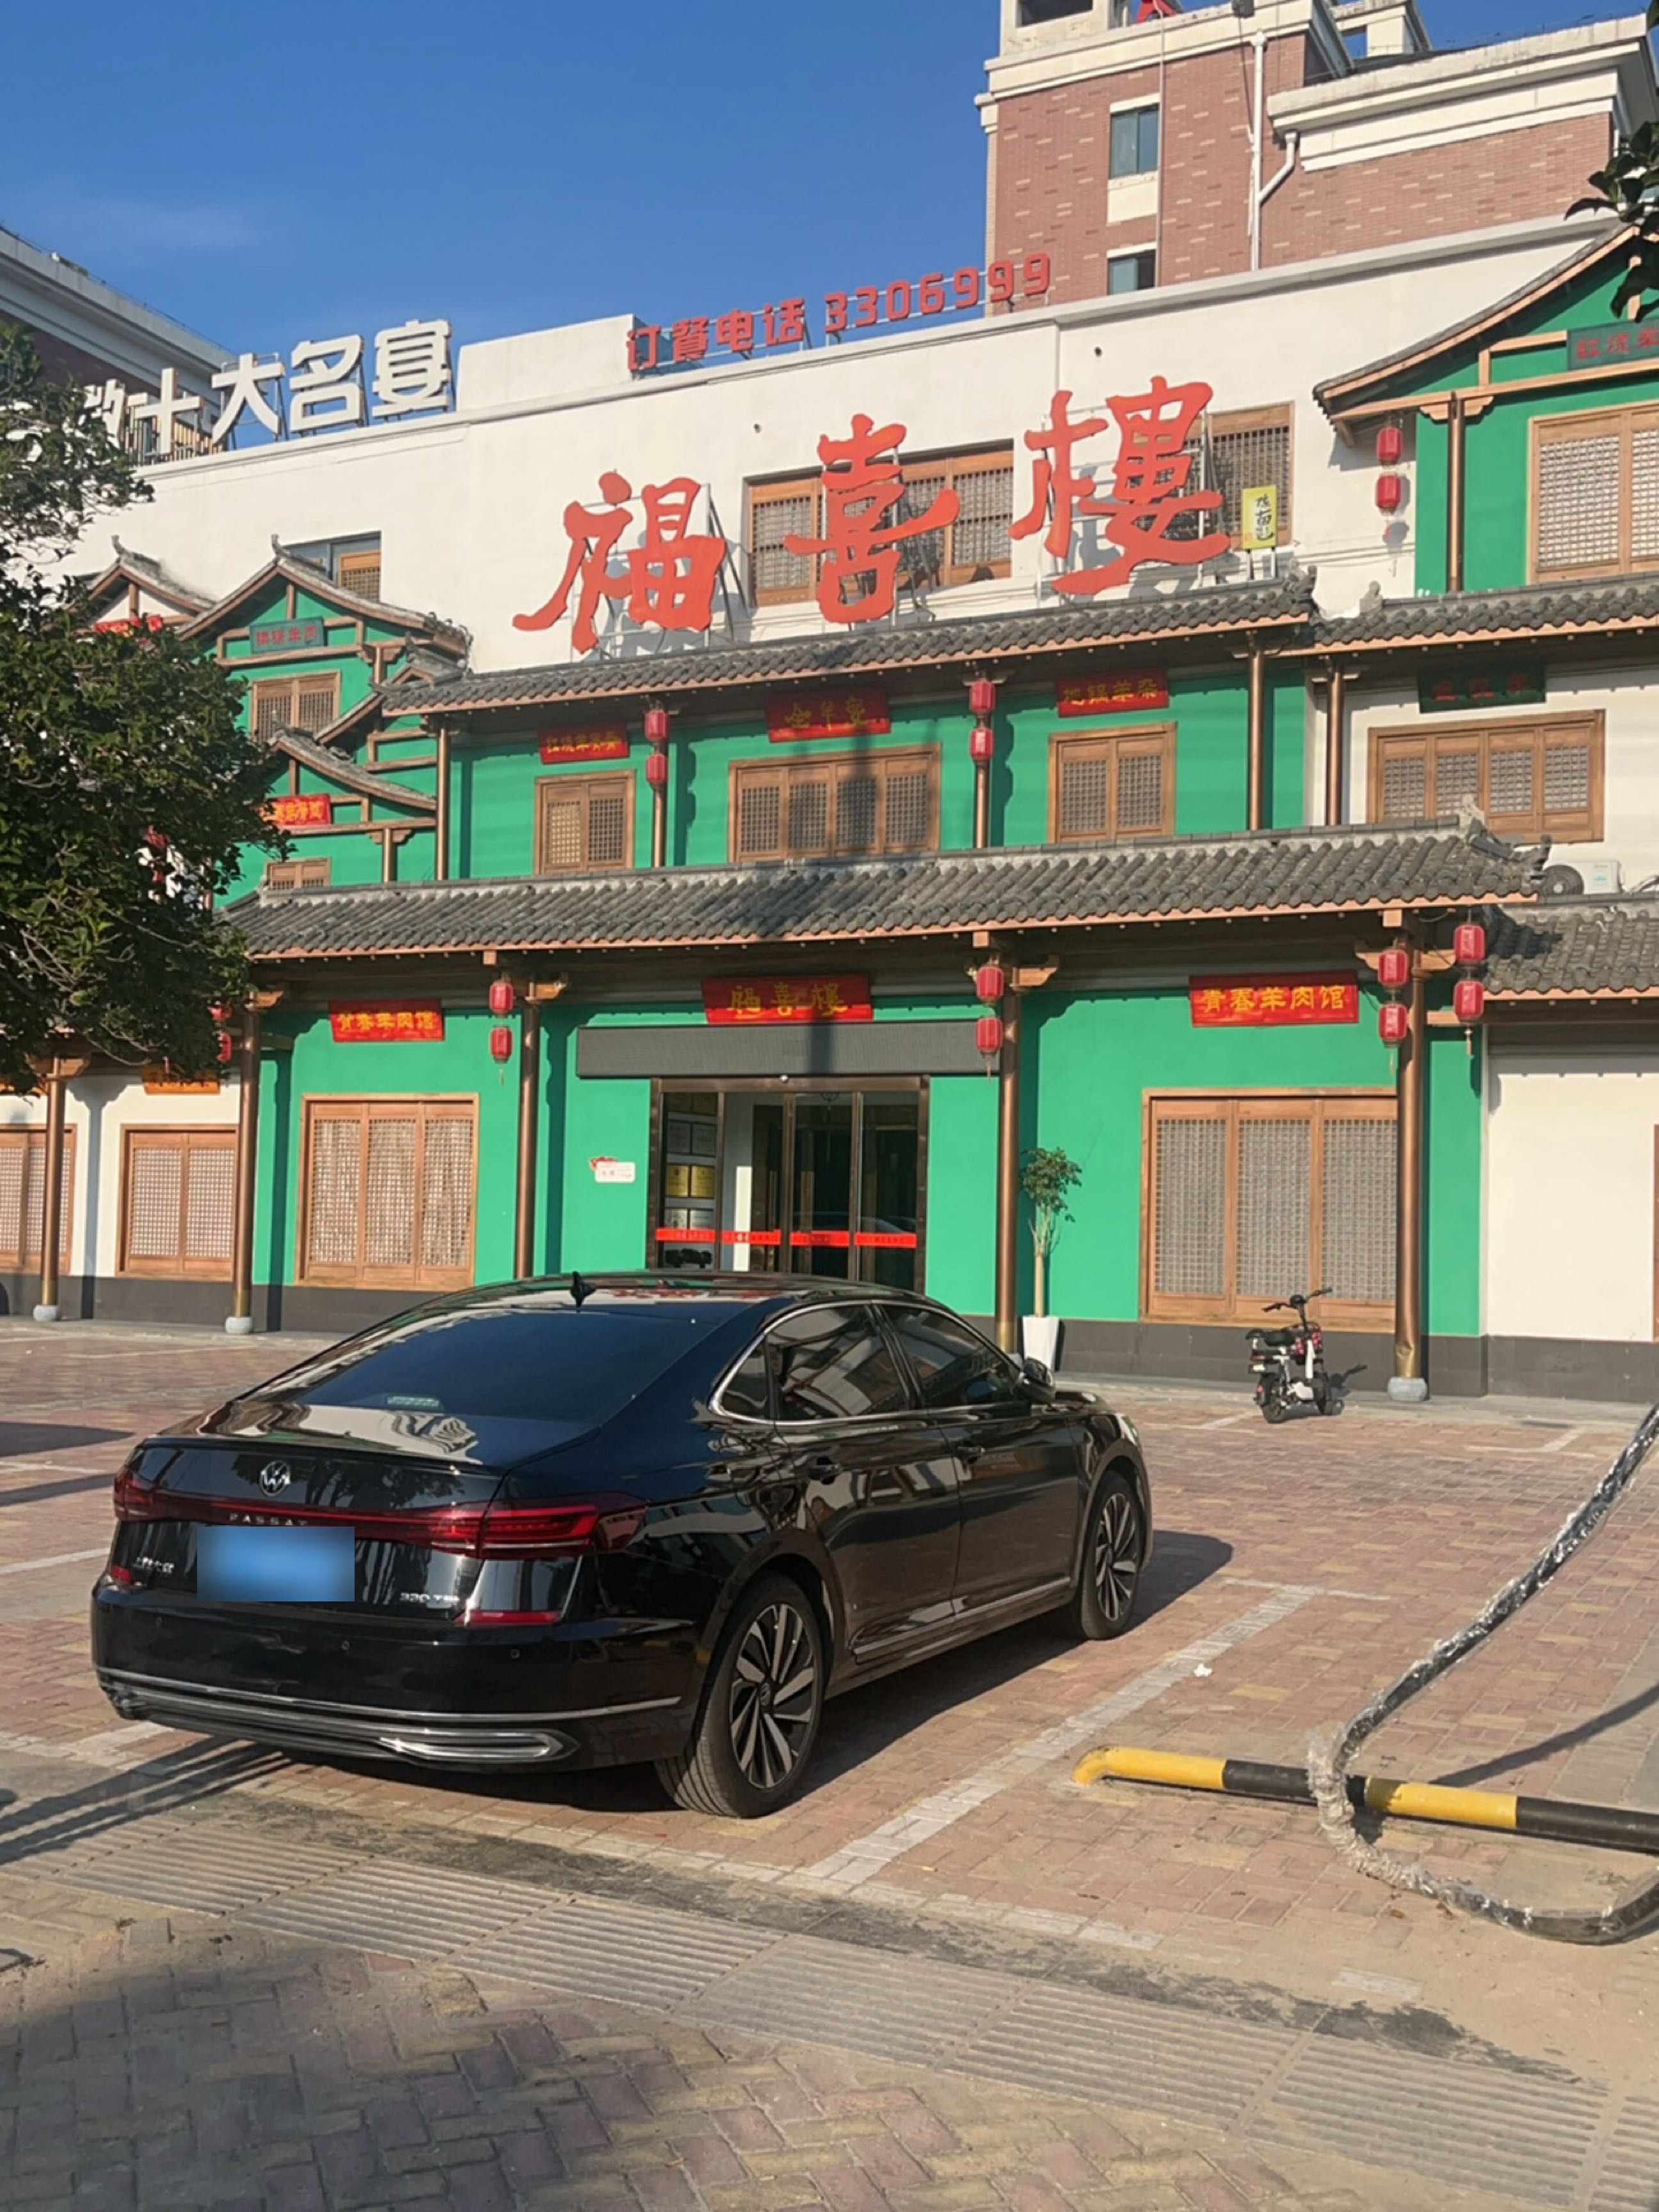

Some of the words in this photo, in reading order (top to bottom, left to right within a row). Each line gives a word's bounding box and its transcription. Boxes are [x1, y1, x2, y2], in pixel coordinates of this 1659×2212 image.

[627, 297, 805, 371] 订餐电话
[823, 252, 1051, 333] 3306999
[1200, 984, 1346, 1014] 青春羊肉馆
